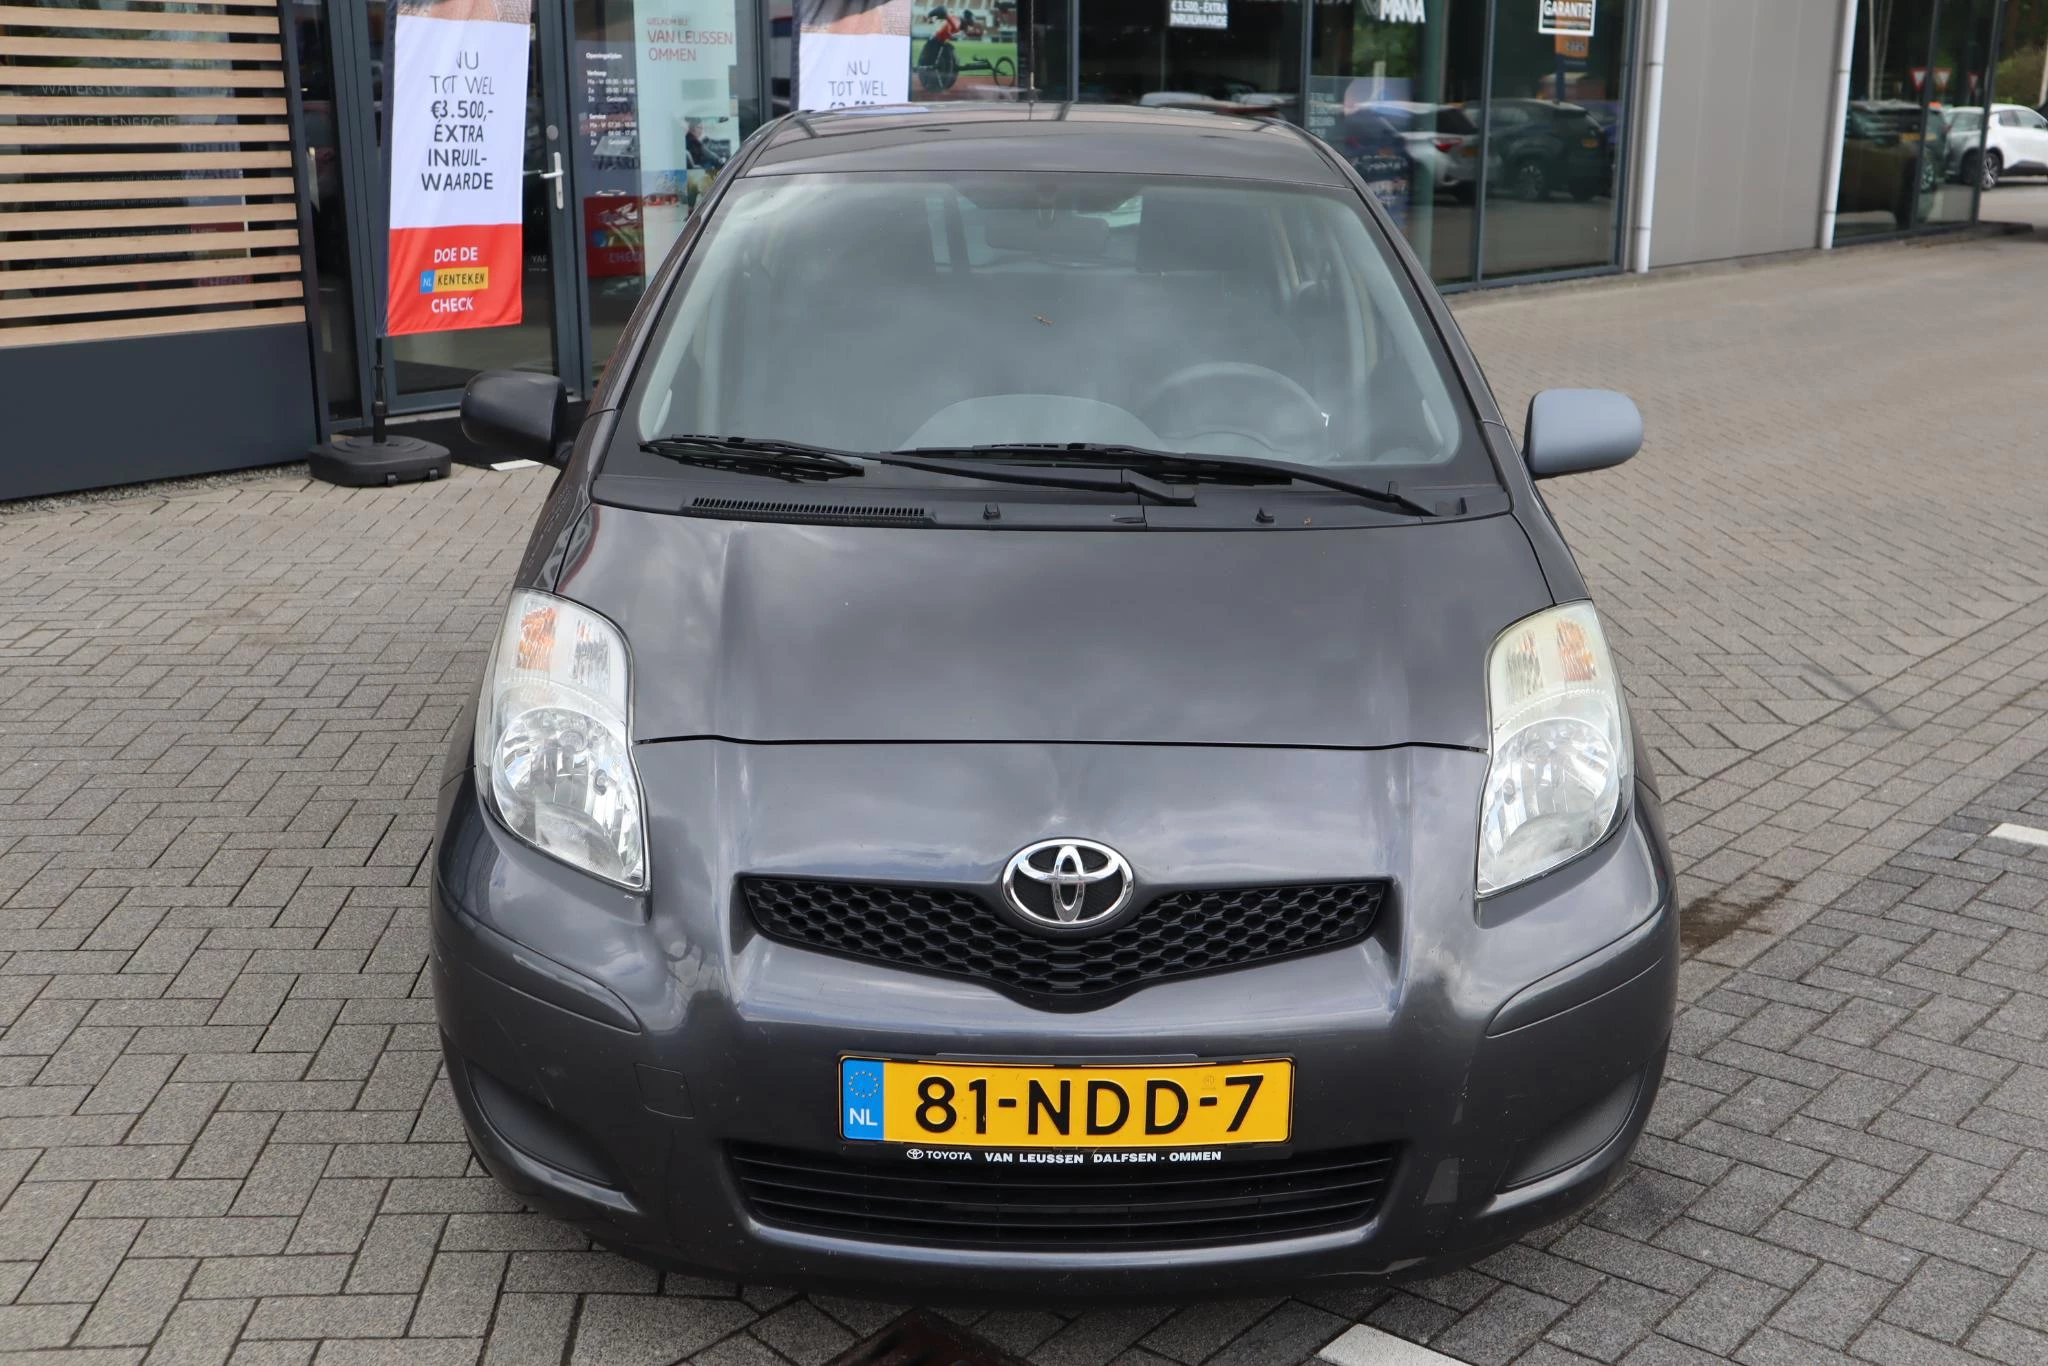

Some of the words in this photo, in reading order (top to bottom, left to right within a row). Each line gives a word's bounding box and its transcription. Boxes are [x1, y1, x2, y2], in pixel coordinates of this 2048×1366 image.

[1543, 0, 1592, 18] GARANTIE
[647, 30, 676, 43] VAN
[677, 31, 733, 45] LEUSSEN
[649, 47, 697, 61] OMMEN
[846, 60, 871, 76] NU
[464, 76, 495, 95] WEL
[828, 80, 852, 97] TOT
[859, 80, 888, 97] WEL
[430, 99, 494, 122] €3.500,-
[427, 148, 487, 167] INRUIL-
[421, 172, 494, 191] WAARDE
[433, 247, 457, 263] DOE
[460, 247, 478, 261] DE
[422, 277, 432, 287] NL
[437, 273, 485, 286] KENTEKEN
[431, 297, 474, 313] CHECK
[915, 1074, 1264, 1136] 81-NDD-7
[849, 1107, 878, 1126] NL
[926, 1150, 972, 1161] TOYOTA
[985, 1152, 1013, 1163] VAN
[1019, 1153, 1084, 1164] LEUSSEN
[1093, 1152, 1157, 1164] DALFSEN
[1169, 1151, 1222, 1162] OMMEN
